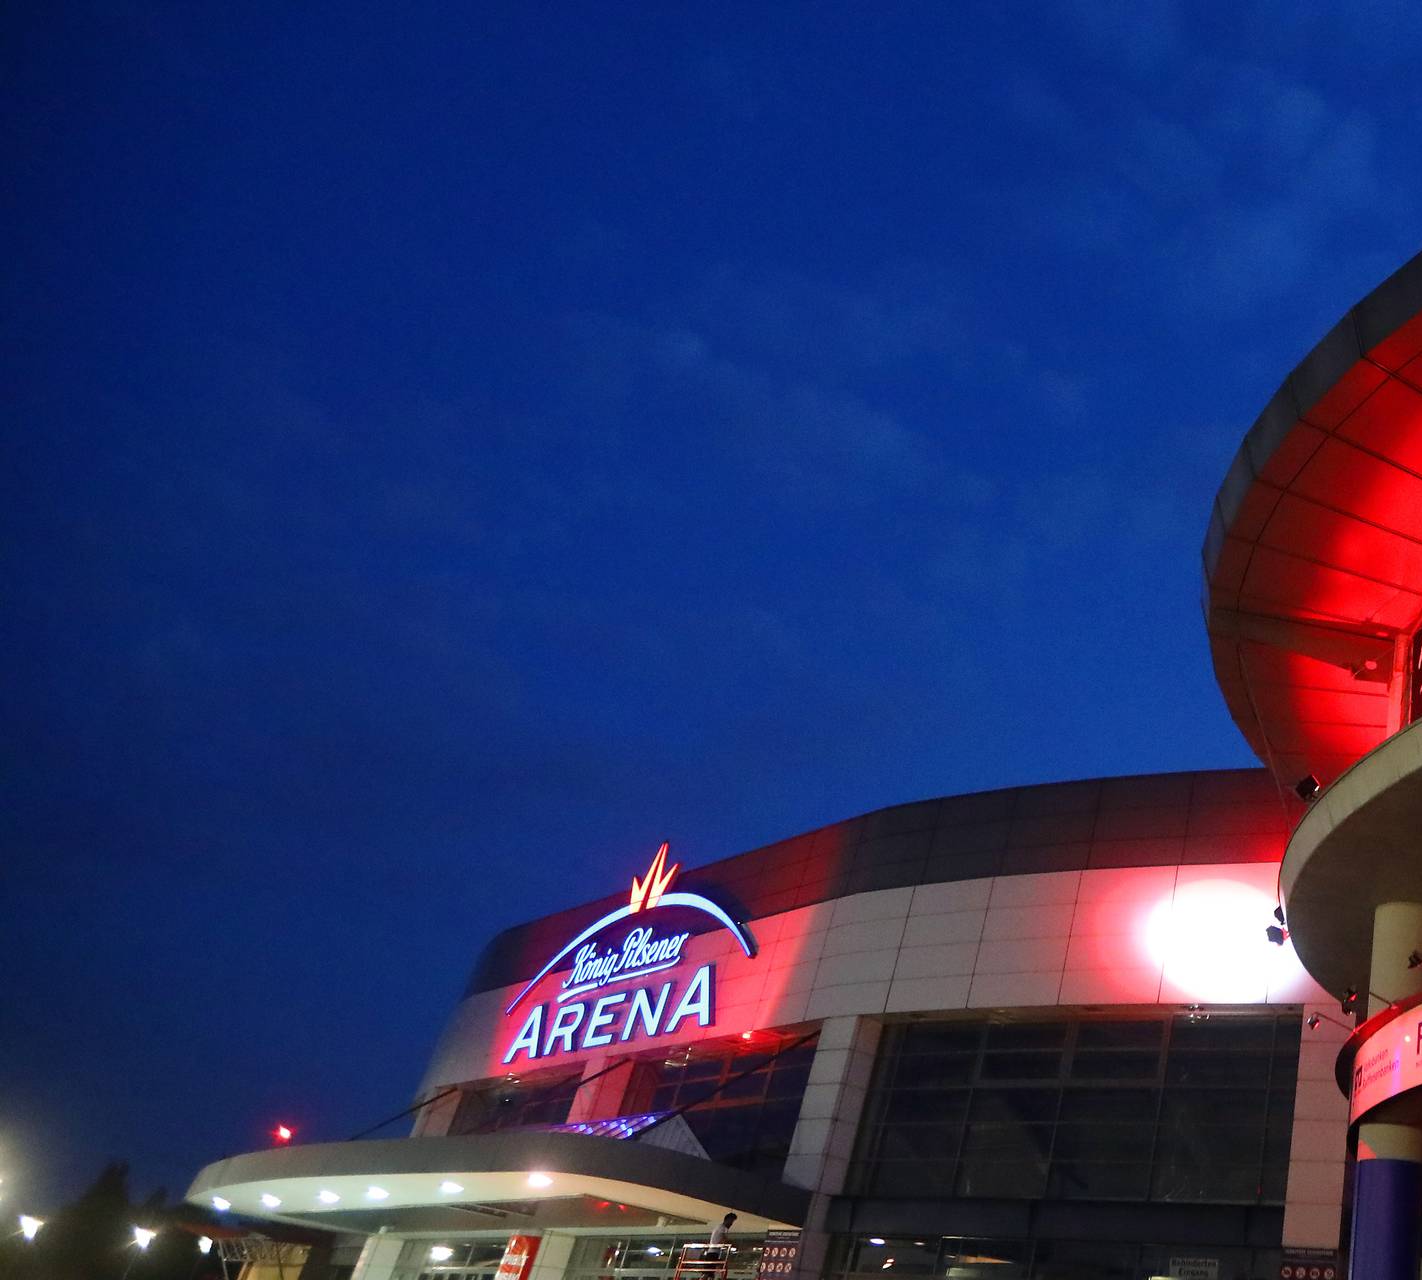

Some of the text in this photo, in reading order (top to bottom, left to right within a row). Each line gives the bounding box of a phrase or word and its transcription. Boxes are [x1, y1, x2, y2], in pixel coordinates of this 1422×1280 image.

[562, 927, 690, 987] König Pilsener
[502, 965, 714, 1064] ARENA
